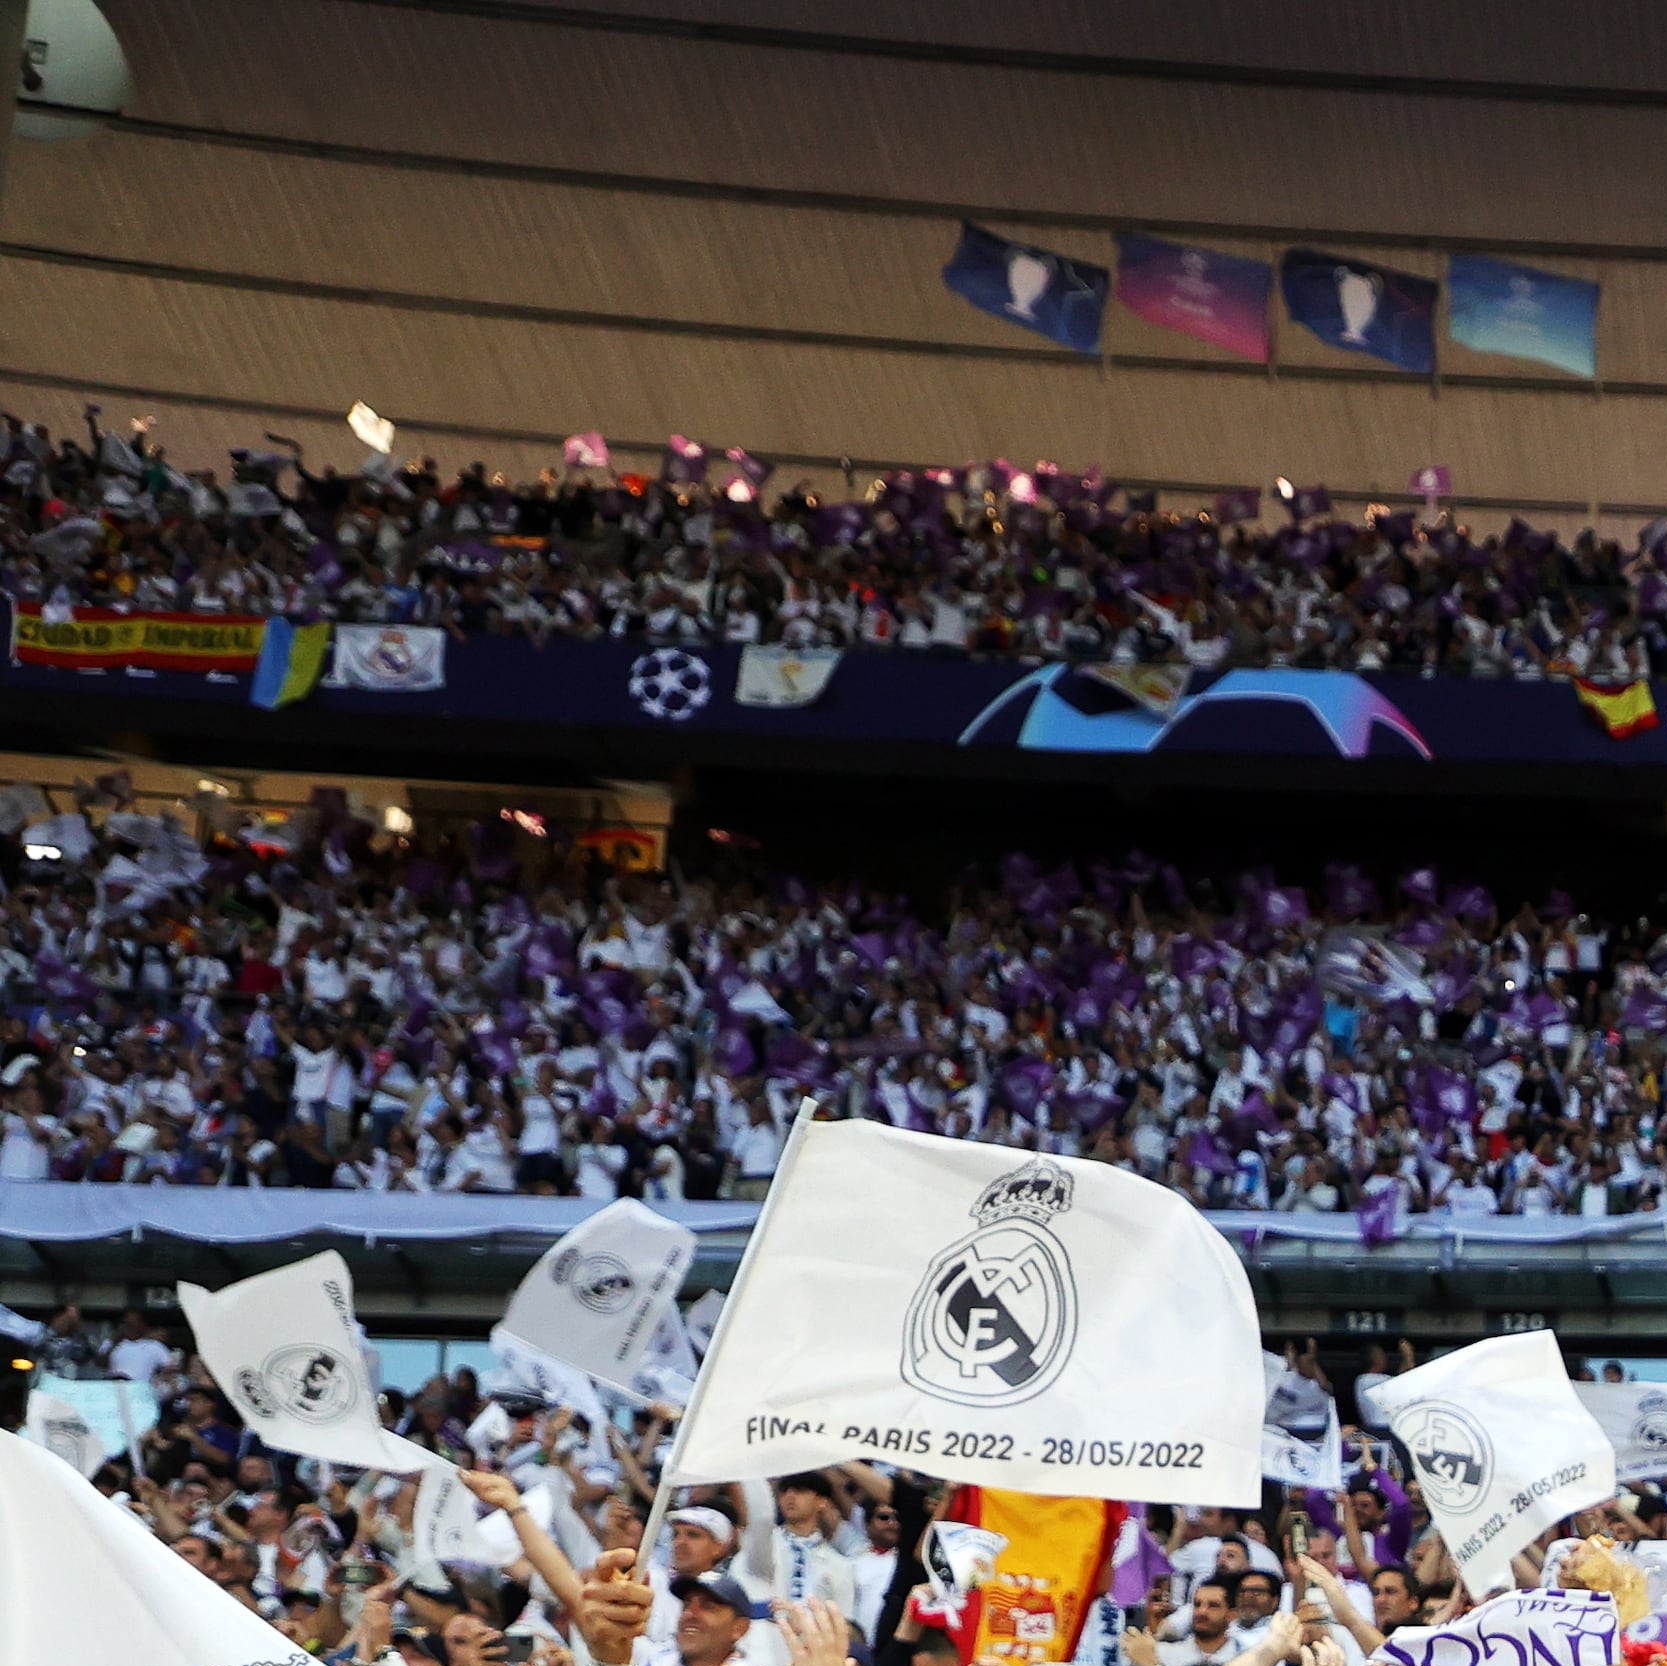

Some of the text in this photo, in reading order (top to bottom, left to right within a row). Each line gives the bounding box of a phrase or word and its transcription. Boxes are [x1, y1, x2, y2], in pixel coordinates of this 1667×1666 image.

[745, 1415, 826, 1446] FINAL
[842, 1424, 932, 1456] PARIS
[943, 1432, 1014, 1462] 2022
[1040, 1437, 1205, 1471] 28/05/2022
[1510, 1462, 1588, 1516] 28/05/2022
